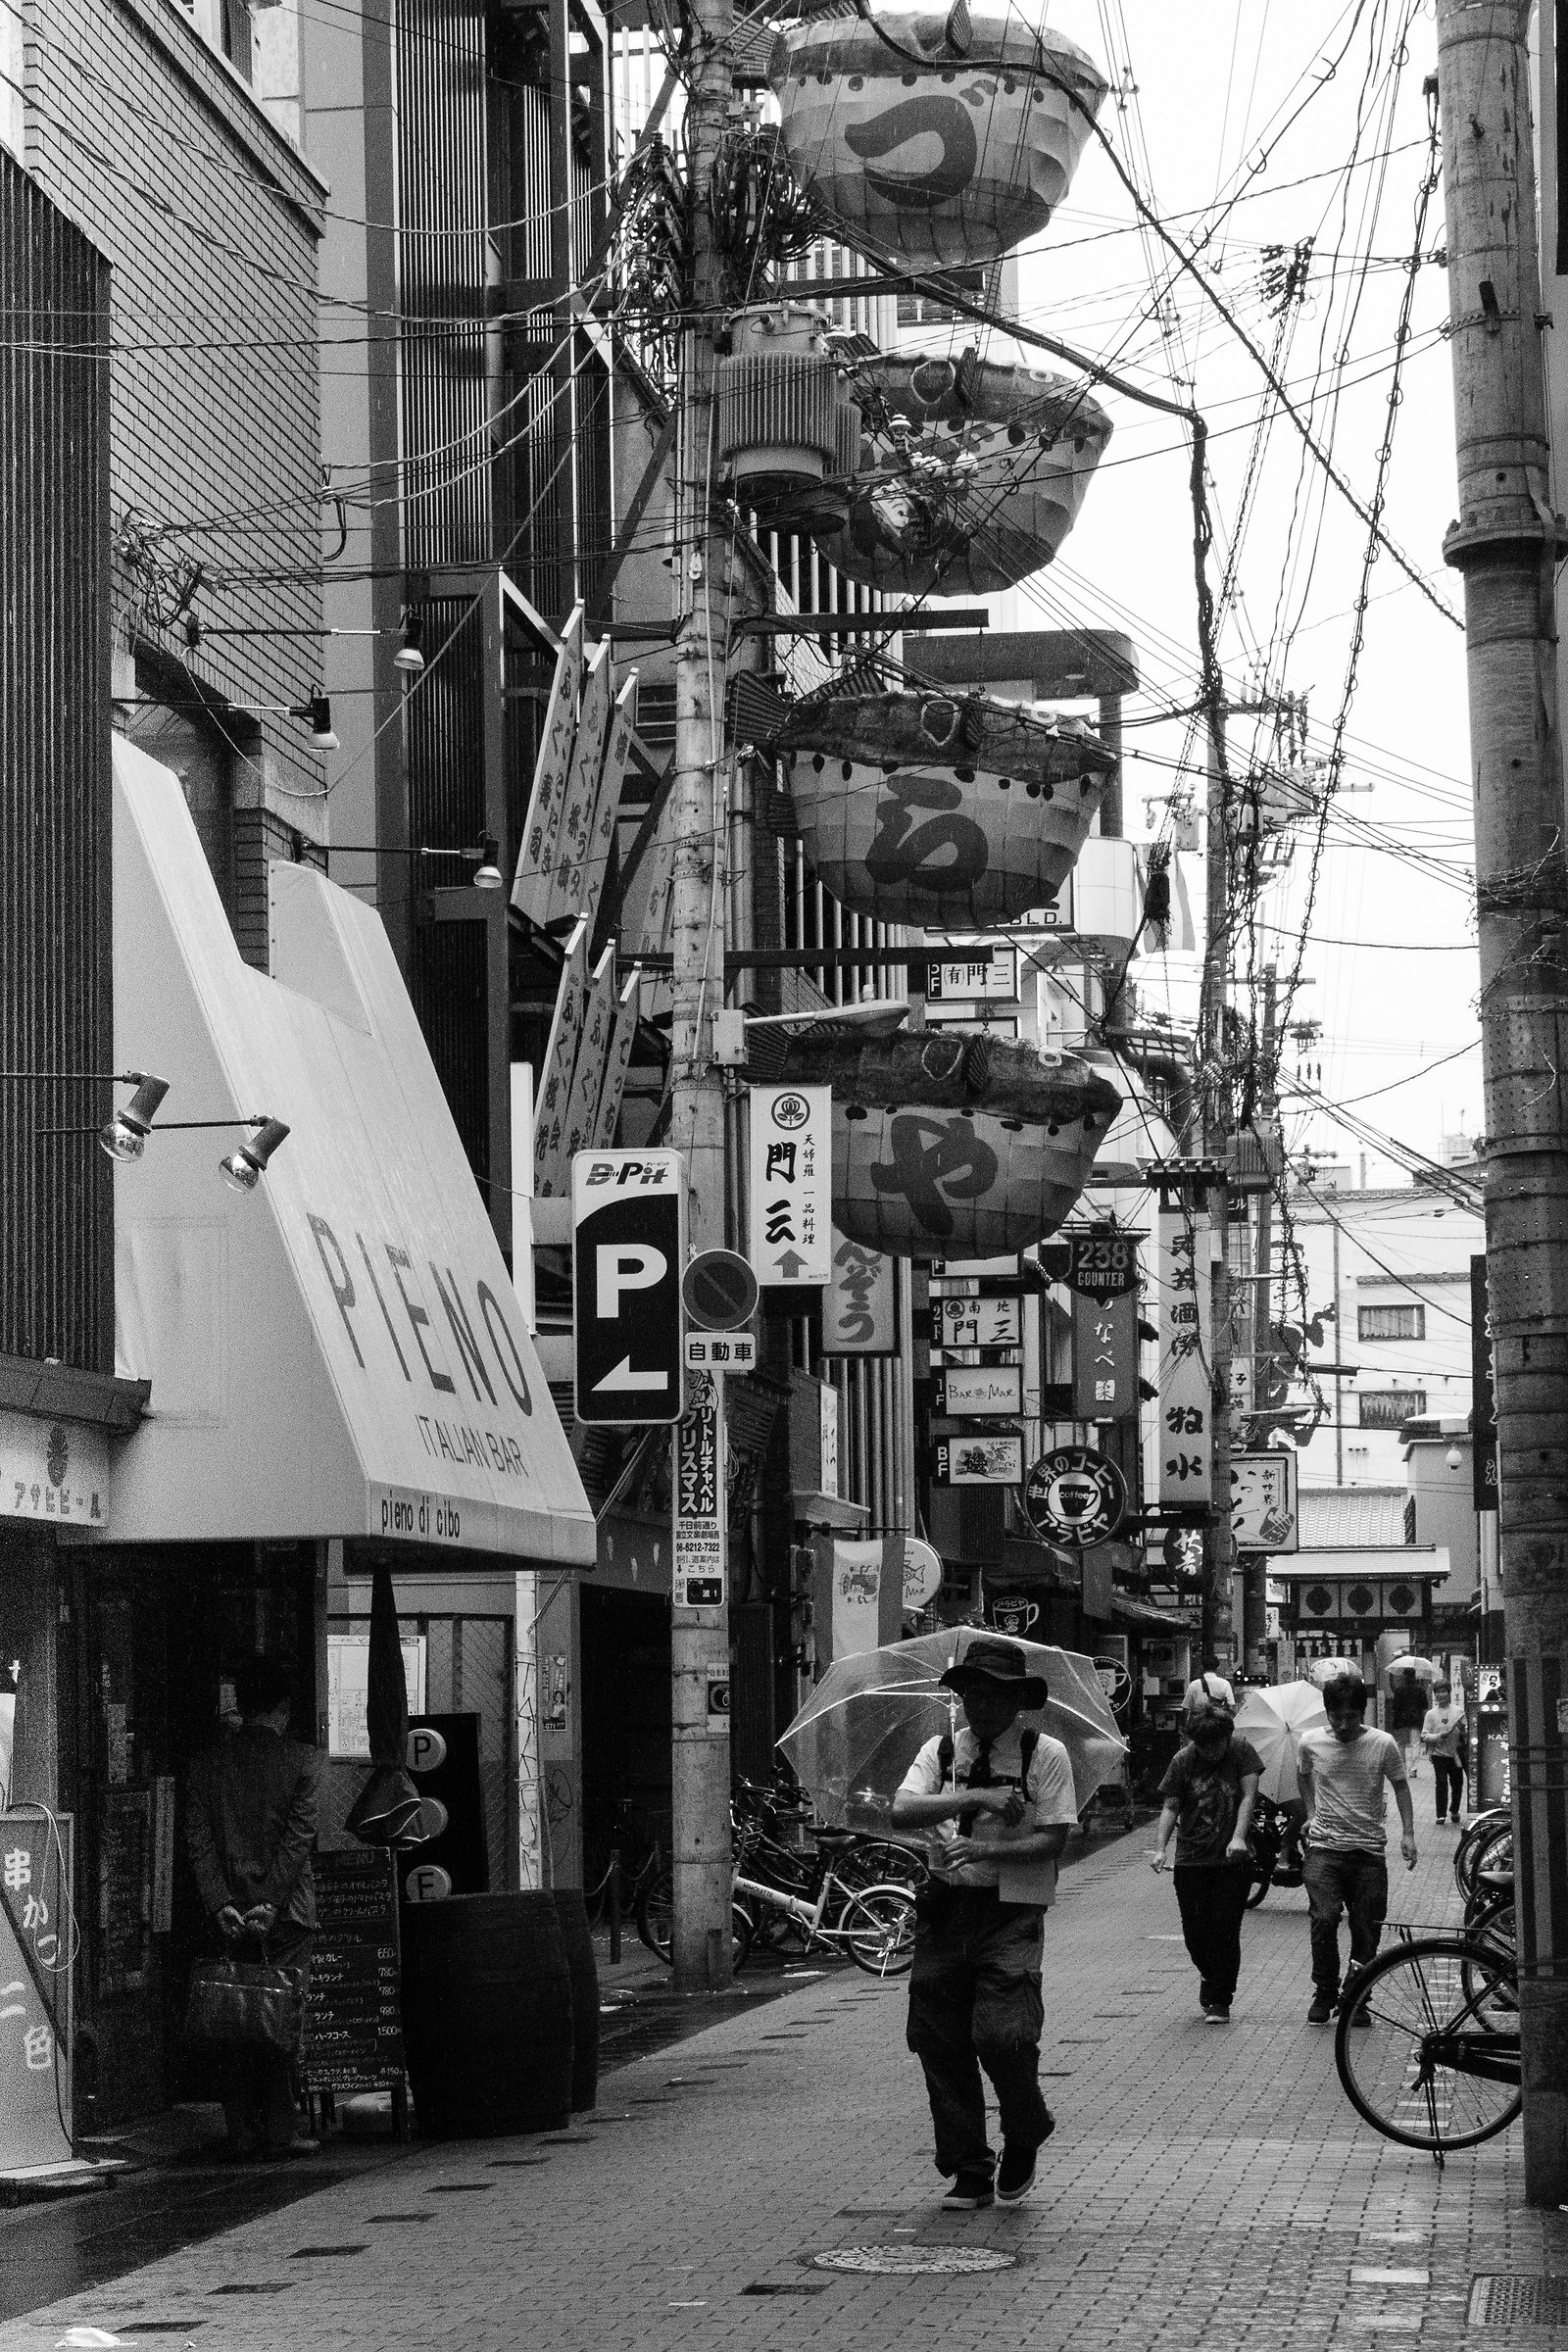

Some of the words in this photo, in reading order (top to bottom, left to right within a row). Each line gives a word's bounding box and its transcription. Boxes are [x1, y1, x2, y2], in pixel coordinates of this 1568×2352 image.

[1077, 1272, 1125, 1287] COUNTER
[1078, 1242, 1127, 1269] 238
[597, 1244, 667, 1318] P
[306, 1212, 532, 1417] PIENO
[689, 1342, 753, 1361] 自動車
[416, 1414, 490, 1469] ITALIAN
[485, 1432, 529, 1478] BAR
[680, 1410, 698, 1513] クリスマス
[699, 1407, 714, 1513] リトルチャペル
[381, 1491, 414, 1535] pieno
[419, 1495, 430, 1535] di
[436, 1499, 461, 1539] cibo
[1058, 1491, 1090, 1500] coffee
[414, 1736, 431, 1766] P
